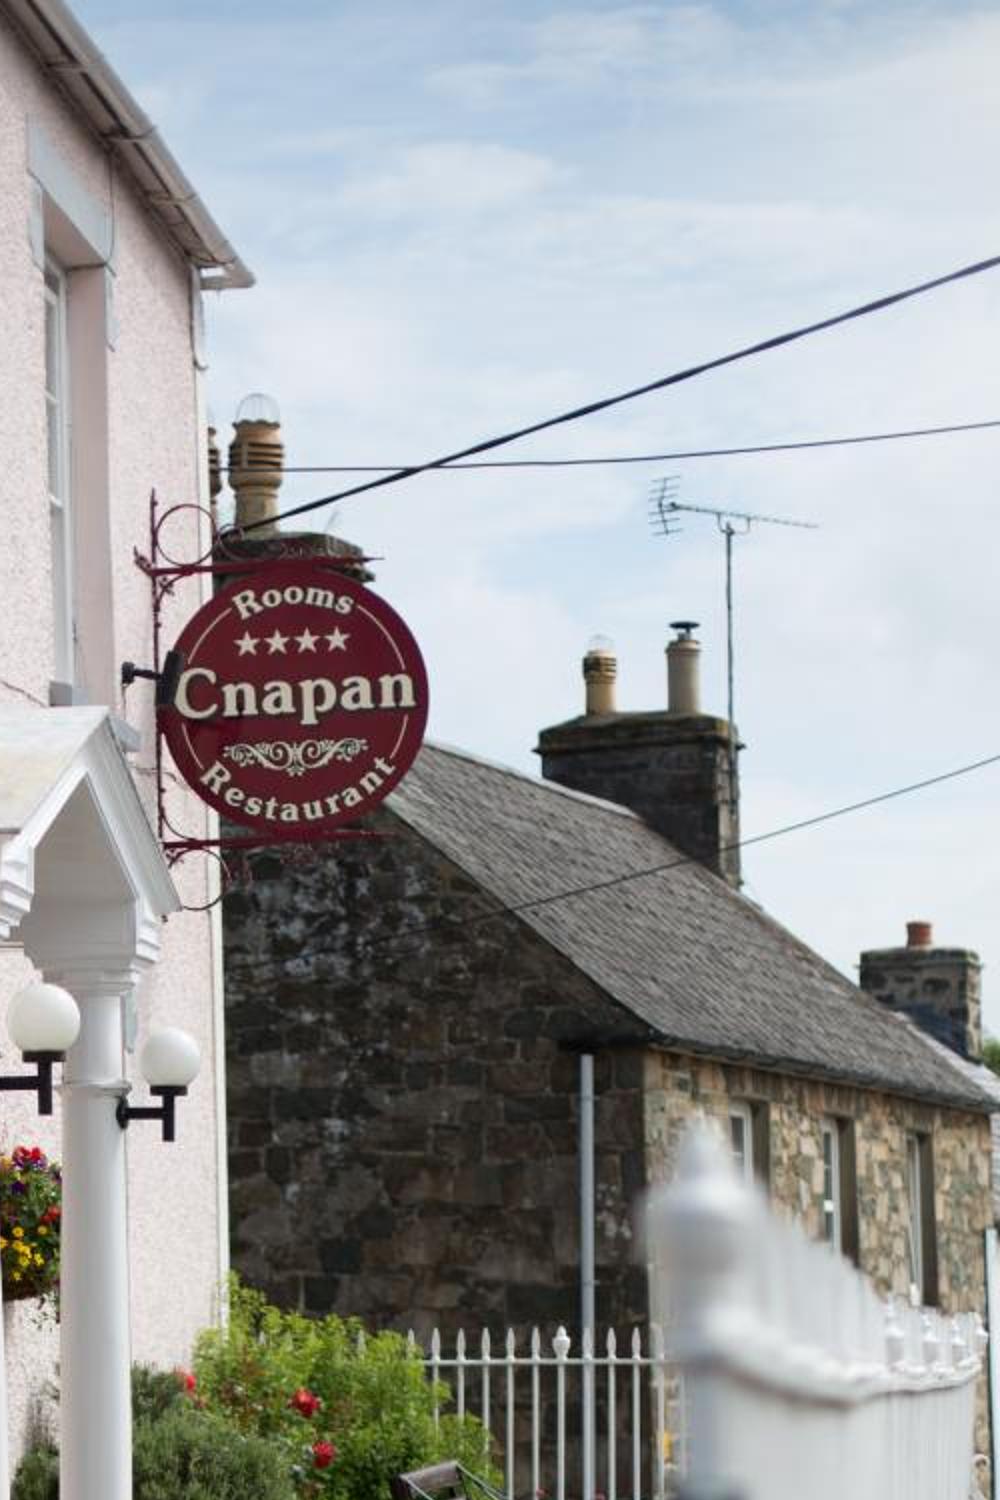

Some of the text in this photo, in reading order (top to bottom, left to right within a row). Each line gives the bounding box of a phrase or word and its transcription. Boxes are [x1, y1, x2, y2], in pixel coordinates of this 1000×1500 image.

[232, 586, 354, 620] Rooms
[175, 667, 416, 725] Cnapan
[201, 756, 396, 821] Restaurant
